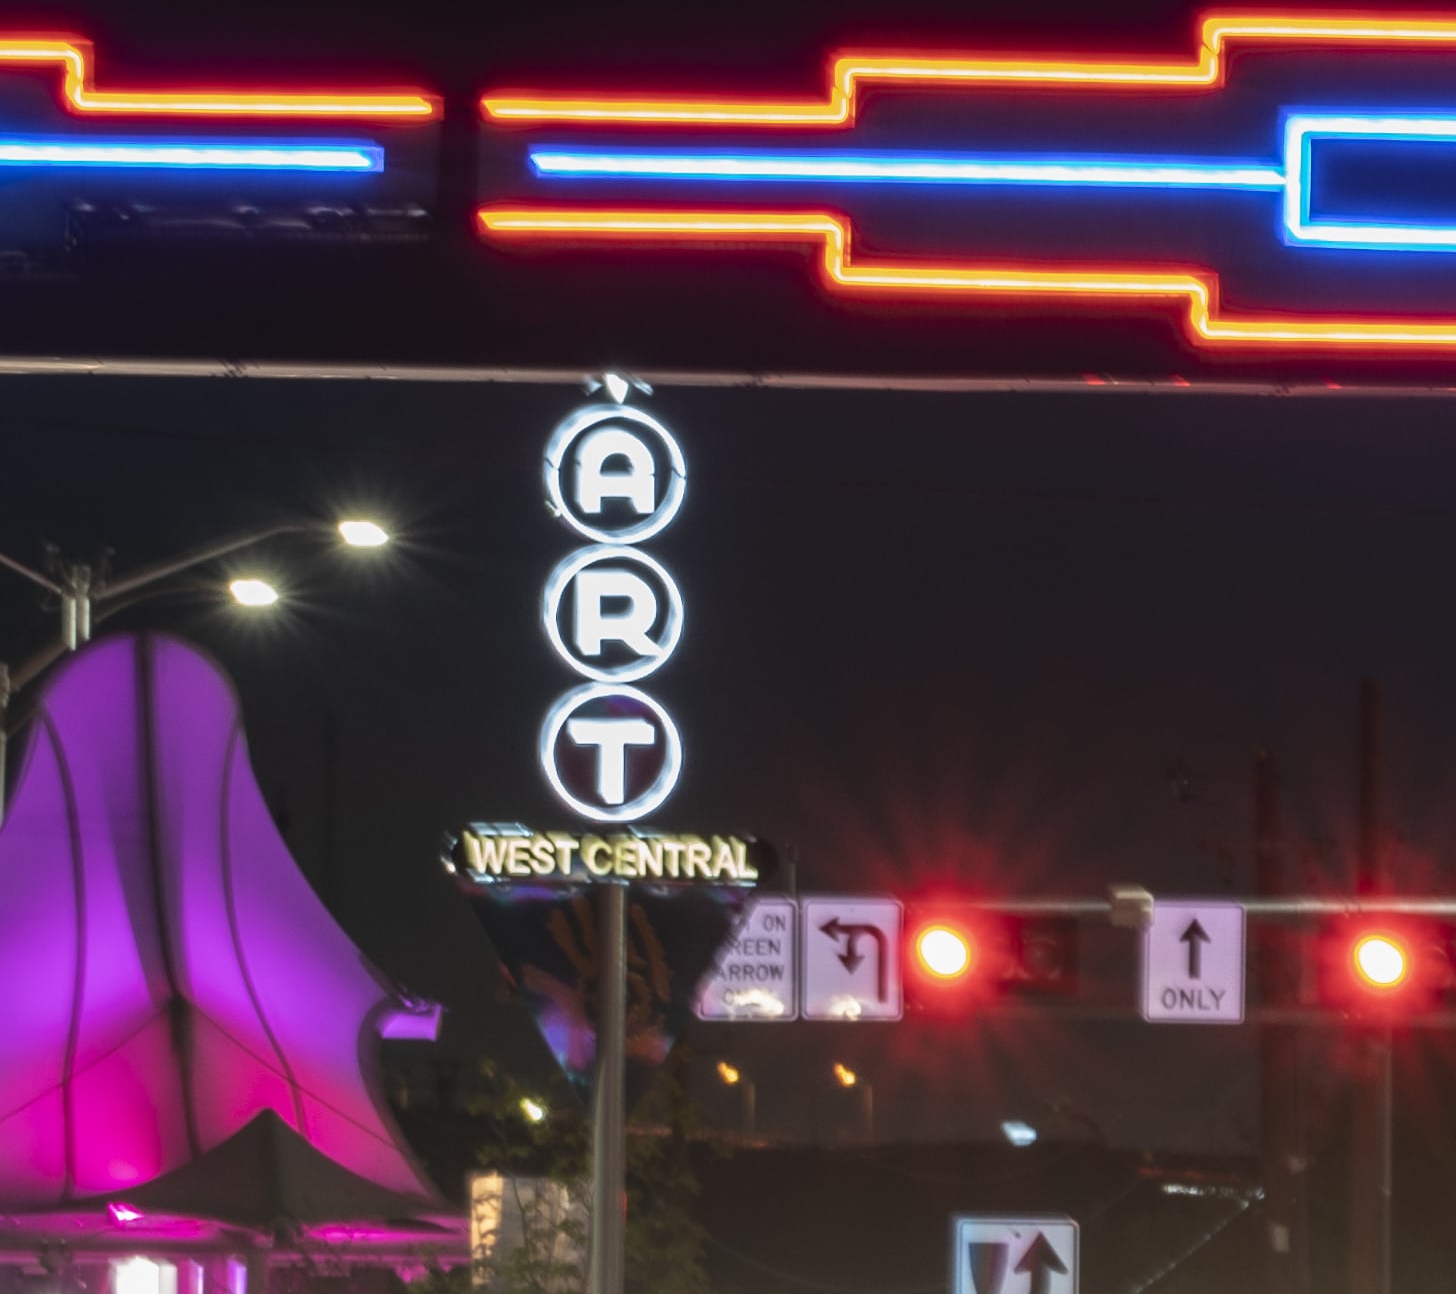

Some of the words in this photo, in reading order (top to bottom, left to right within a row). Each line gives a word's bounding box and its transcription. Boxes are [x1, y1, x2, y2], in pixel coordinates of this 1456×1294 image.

[568, 426, 666, 805] ART
[465, 832, 579, 876] WEST
[582, 834, 759, 880] CENTRAL
[762, 914, 787, 933] ON
[731, 938, 782, 956] REEN
[1161, 988, 1226, 1012] ONLY
